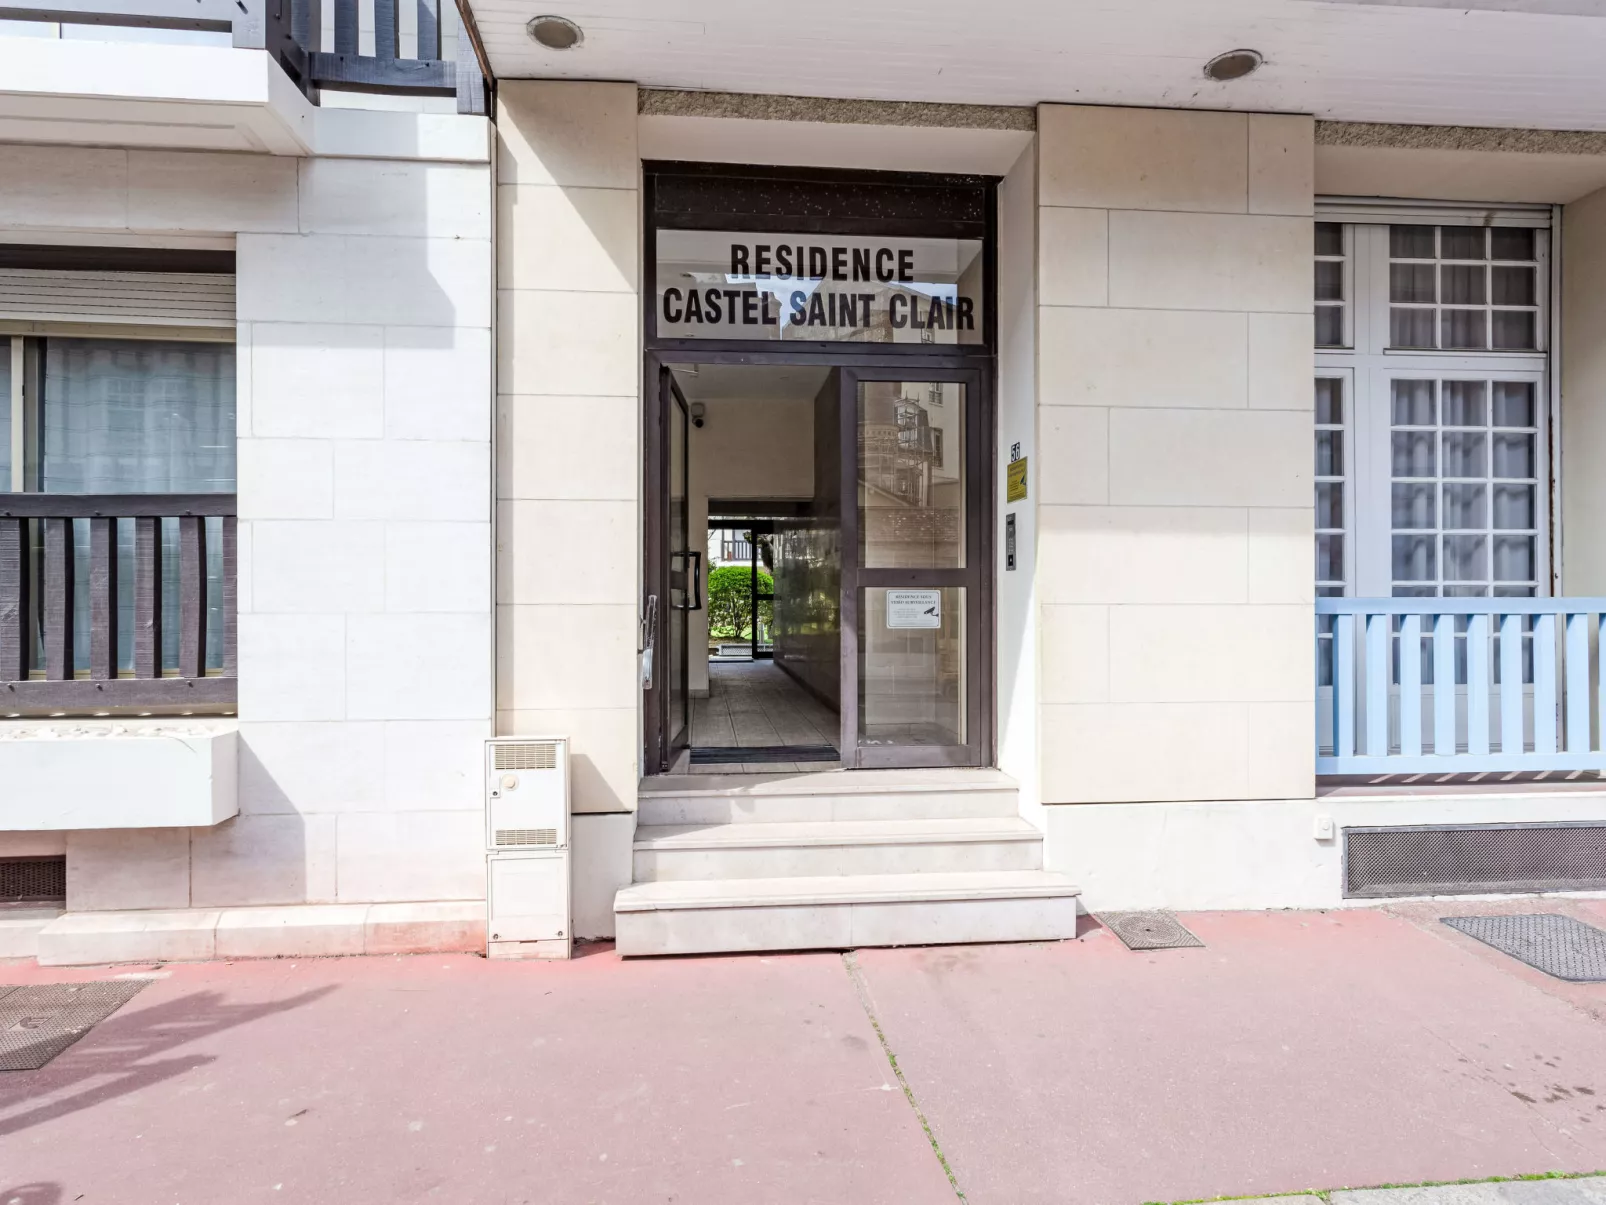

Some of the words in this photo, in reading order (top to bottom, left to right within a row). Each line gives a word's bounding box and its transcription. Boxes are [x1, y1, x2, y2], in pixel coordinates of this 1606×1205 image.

[731, 244, 914, 283] RESIDENCE
[663, 287, 777, 325] CASTEL
[789, 290, 875, 328] SAINT
[889, 294, 975, 331] CLAIR
[1011, 443, 1020, 462] 56
